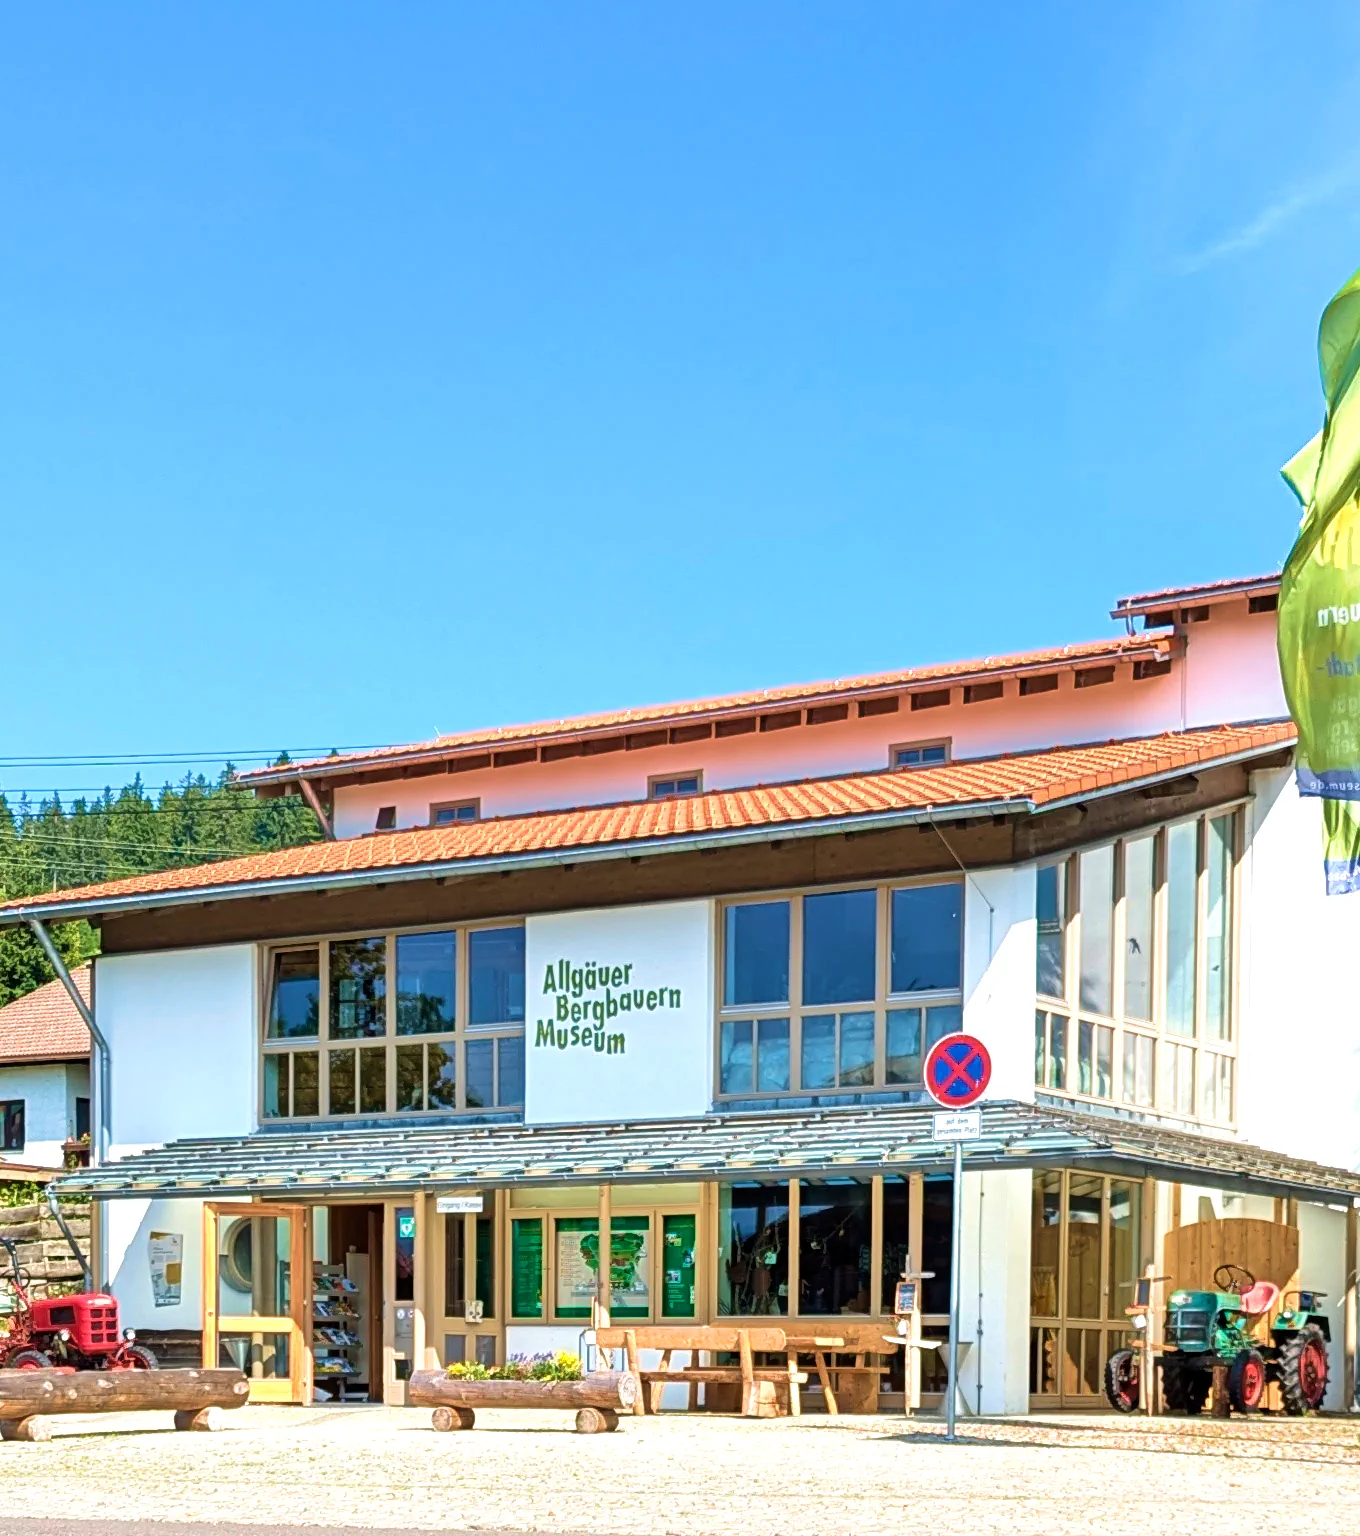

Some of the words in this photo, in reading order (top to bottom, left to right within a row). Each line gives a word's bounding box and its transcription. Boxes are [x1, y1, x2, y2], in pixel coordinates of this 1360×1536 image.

[543, 958, 633, 998] Allgäuer
[556, 987, 681, 1031] Bergbauern
[535, 1018, 625, 1055] Museum
